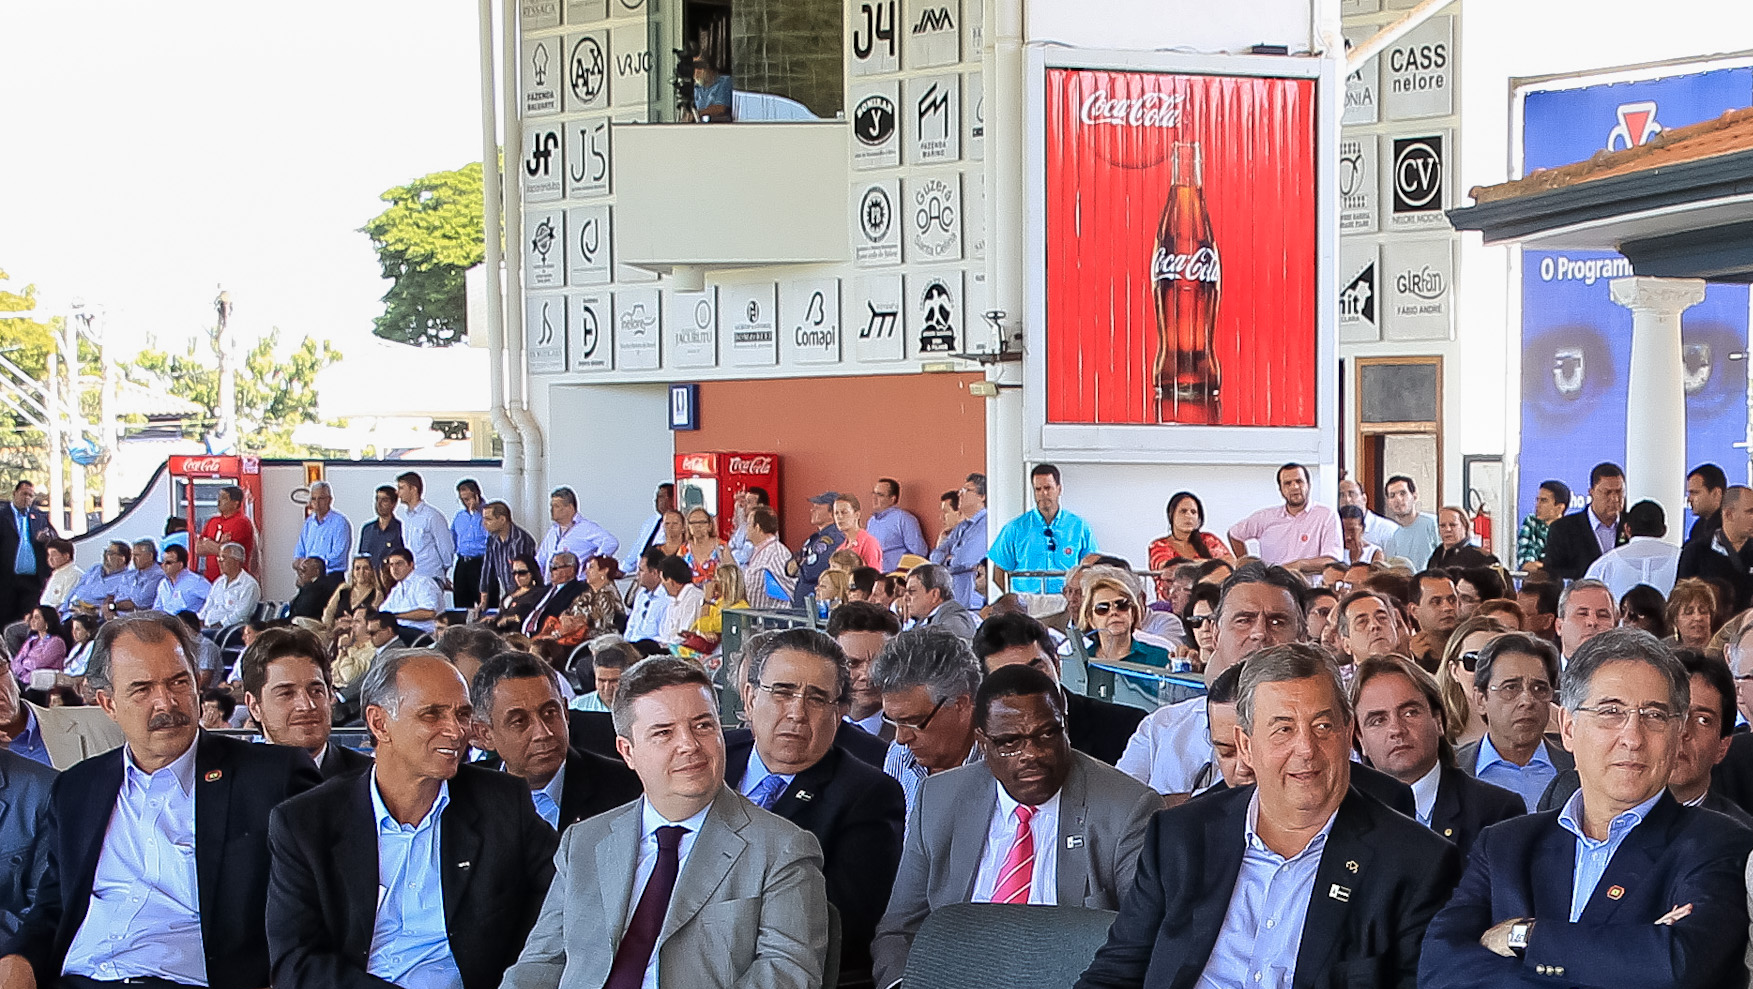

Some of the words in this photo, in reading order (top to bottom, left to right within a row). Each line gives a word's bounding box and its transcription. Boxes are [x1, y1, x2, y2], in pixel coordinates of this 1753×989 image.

[1390, 43, 1447, 73] CASS
[1392, 73, 1445, 93] nelore
[1081, 90, 1186, 128] Coca-Cola
[1400, 157, 1435, 193] CV
[1541, 257, 1555, 281] O
[795, 325, 836, 351] Comapi
[182, 458, 220, 472] Coca-Cola
[729, 456, 773, 475] Coca-Cola
